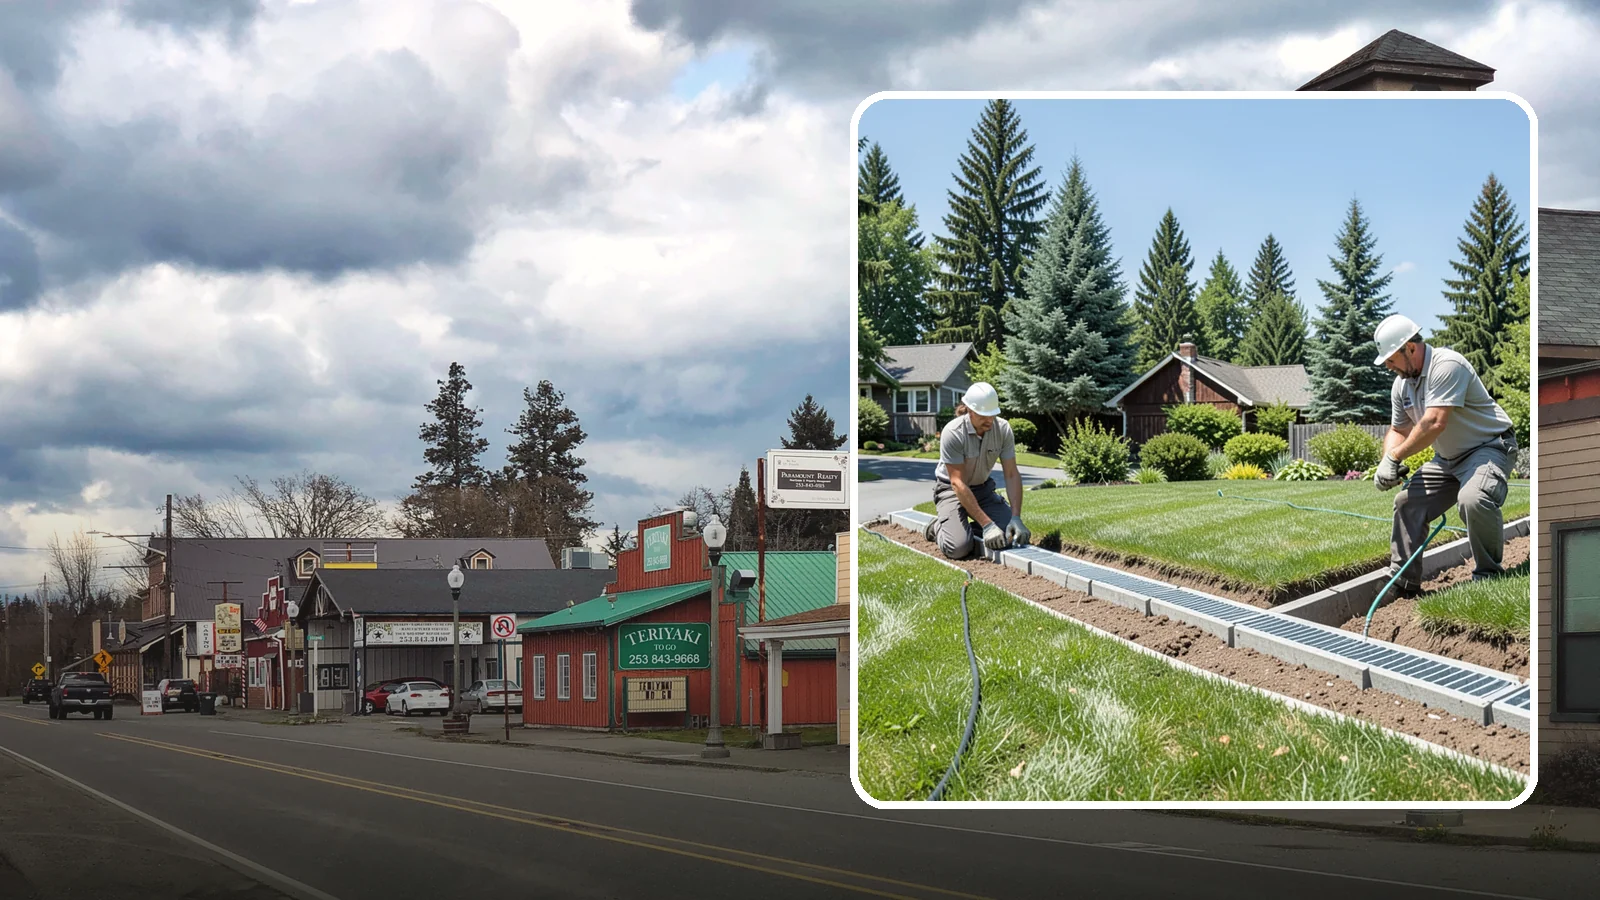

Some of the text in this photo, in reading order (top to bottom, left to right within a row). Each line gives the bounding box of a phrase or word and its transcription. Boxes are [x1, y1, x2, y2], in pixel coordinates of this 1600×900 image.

[781, 471, 839, 480] PARAMOUNT REALTY
[624, 627, 702, 646] TERIYAKI
[653, 643, 677, 651] TO GO
[628, 653, 700, 665] 253 843-9668
